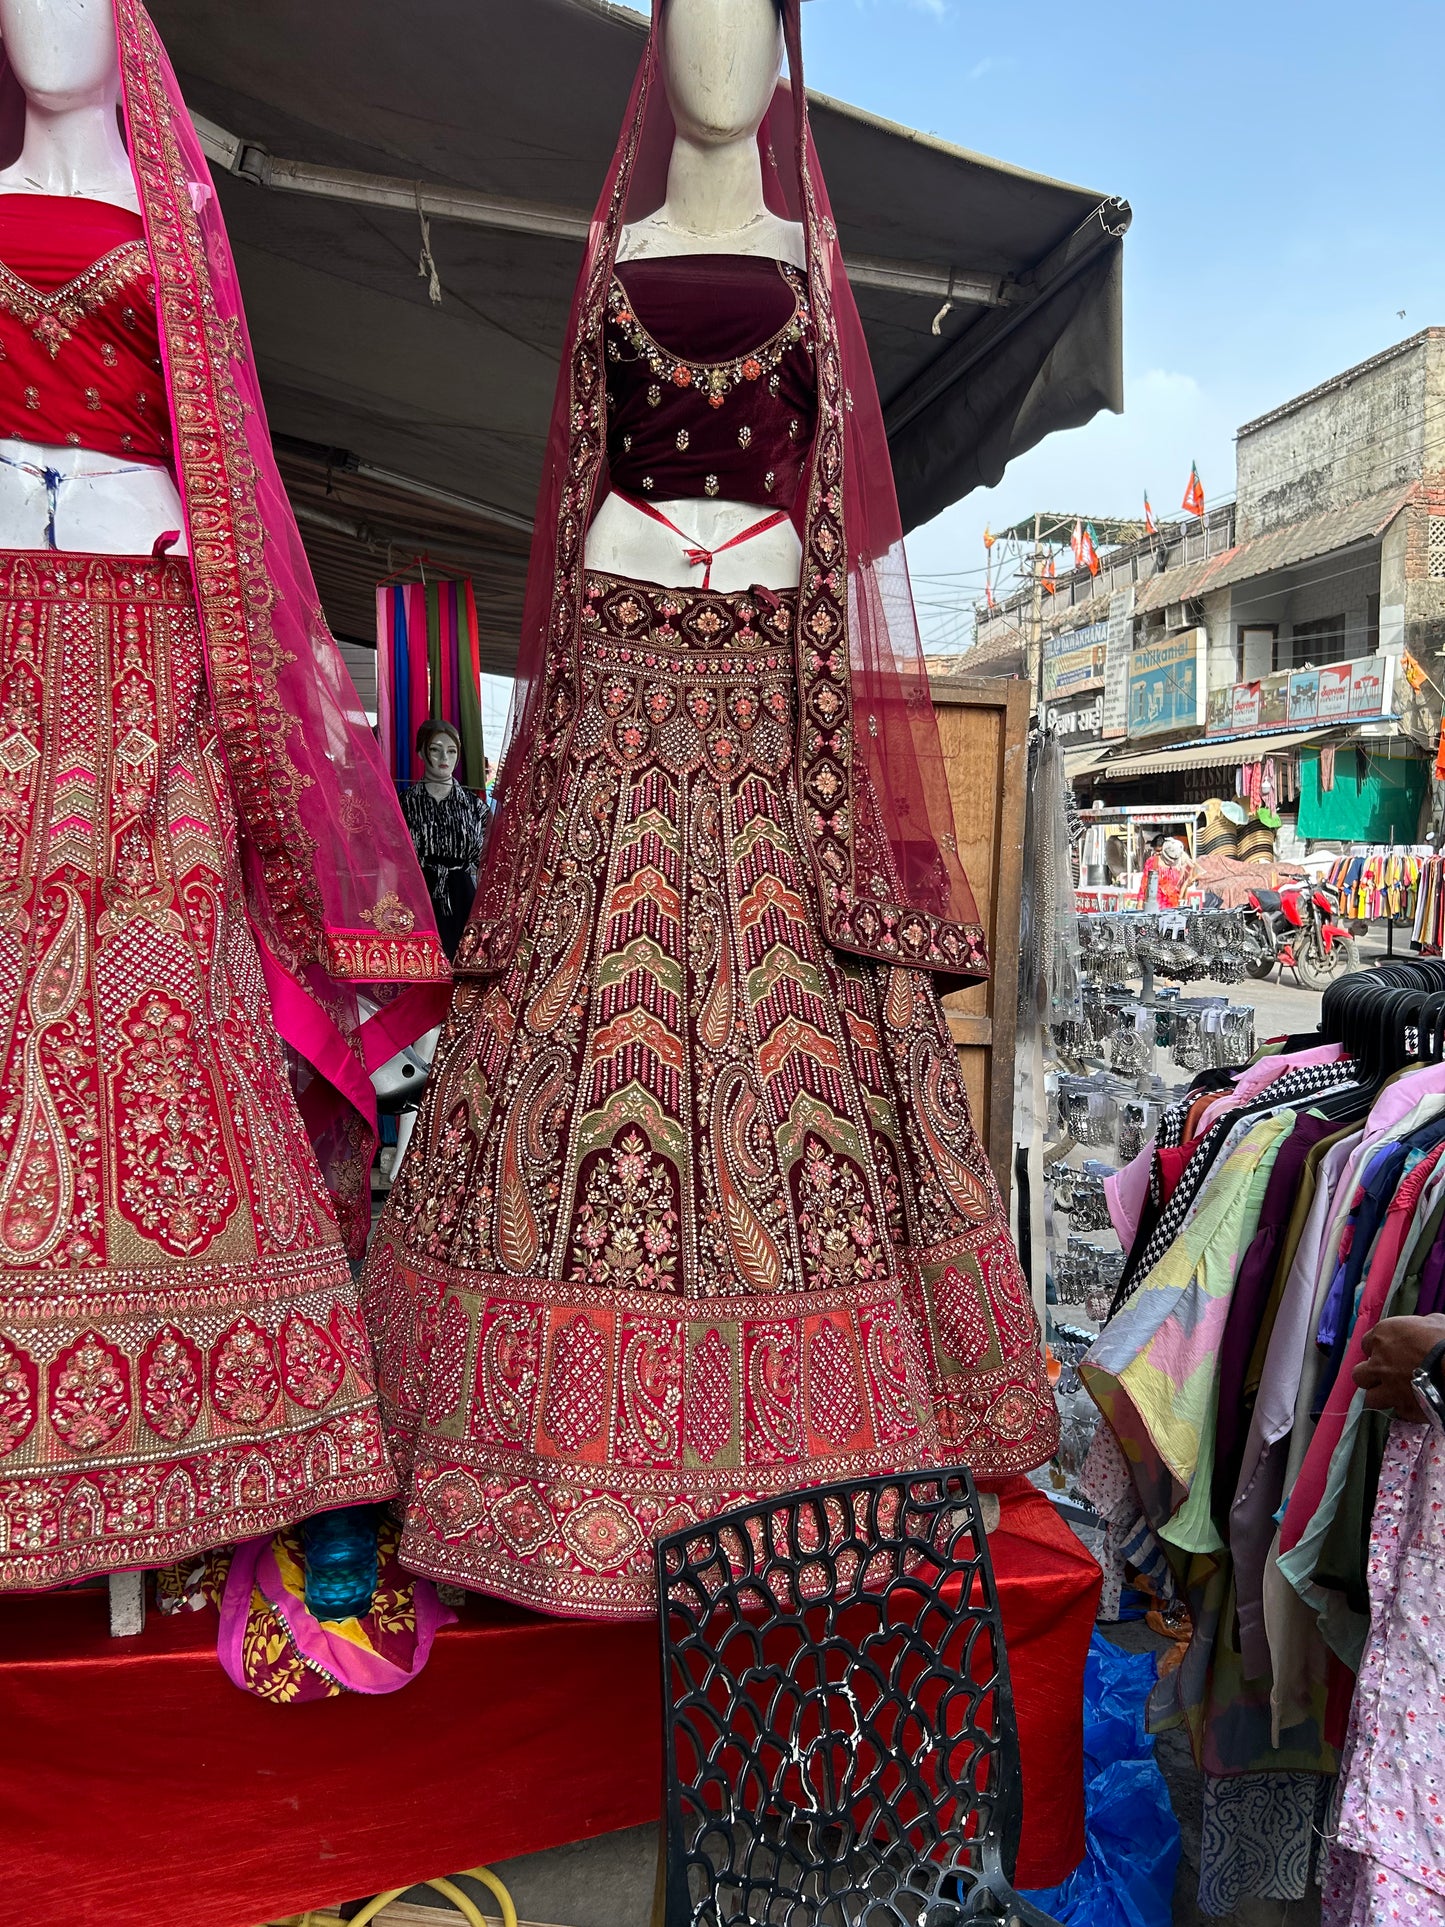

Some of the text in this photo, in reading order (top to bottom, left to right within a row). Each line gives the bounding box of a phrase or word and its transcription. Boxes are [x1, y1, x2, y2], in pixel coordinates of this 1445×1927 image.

[1062, 624, 1108, 652] DAWAKHANA
[1142, 638, 1188, 669] Nilkamal
[1184, 766, 1235, 788] CLASSIC
